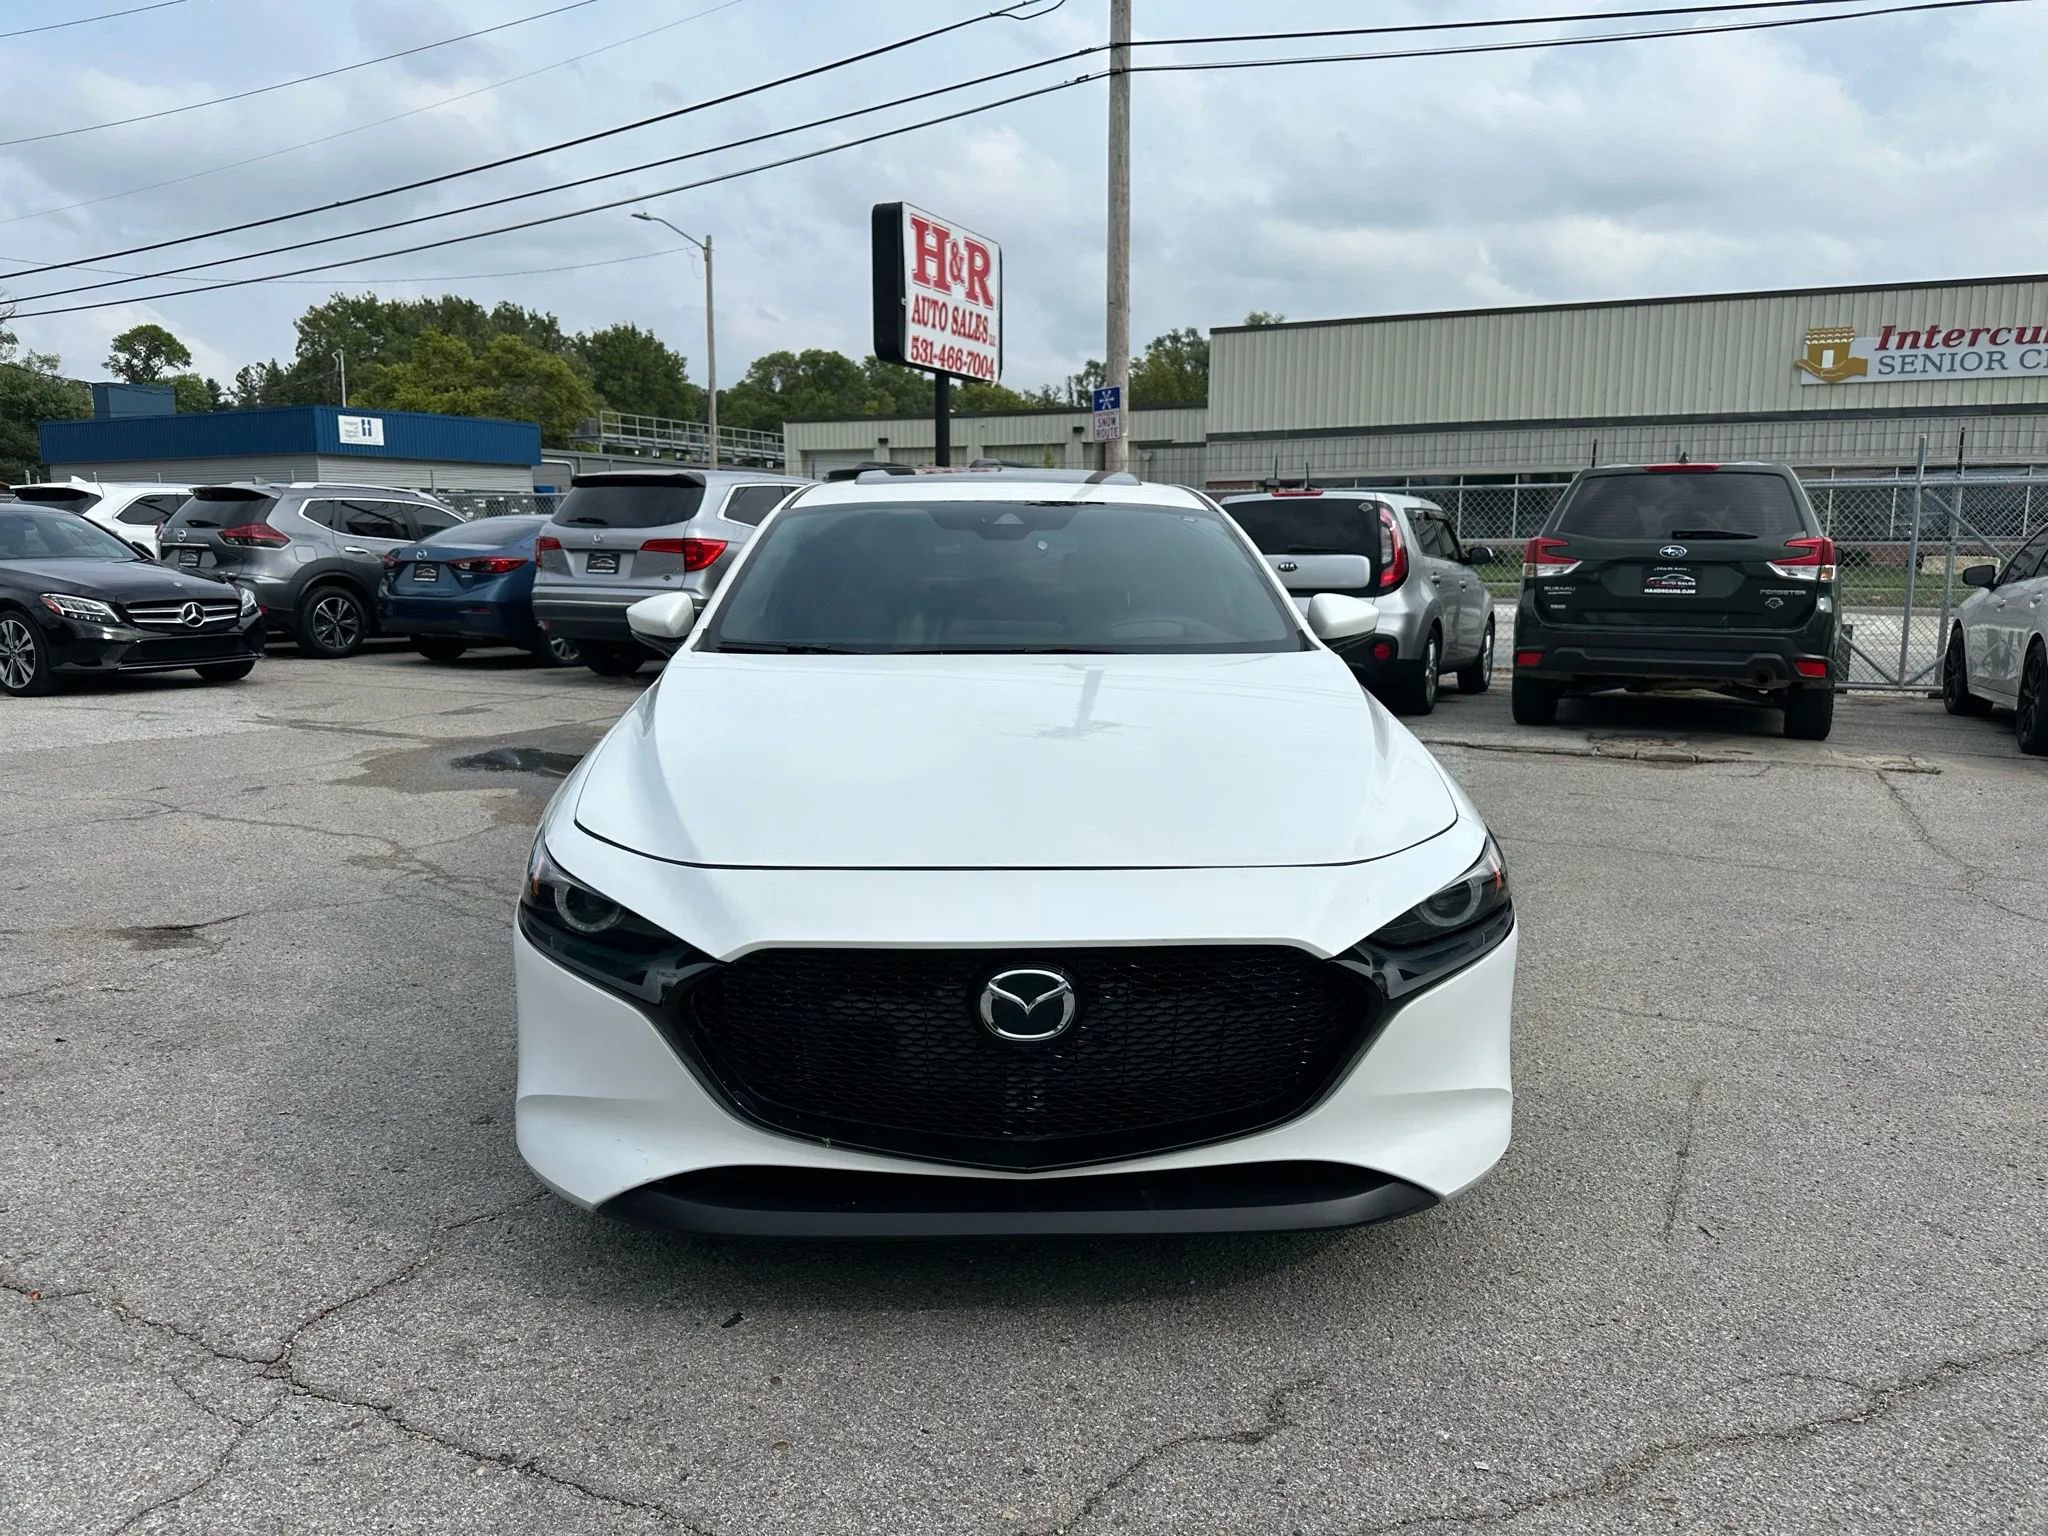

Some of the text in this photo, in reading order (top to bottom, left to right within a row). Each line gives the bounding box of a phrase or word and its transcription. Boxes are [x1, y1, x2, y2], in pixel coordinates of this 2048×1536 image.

[910, 213, 994, 310] H&R
[911, 293, 948, 332] AUTO
[951, 305, 989, 343] SALES
[910, 335, 995, 380] 531-466-7004
[1878, 350, 2009, 376] SENIOR
[1096, 426, 1119, 439] ROUTE
[1097, 416, 1117, 429] SNOW
[1279, 562, 1296, 570] KIA
